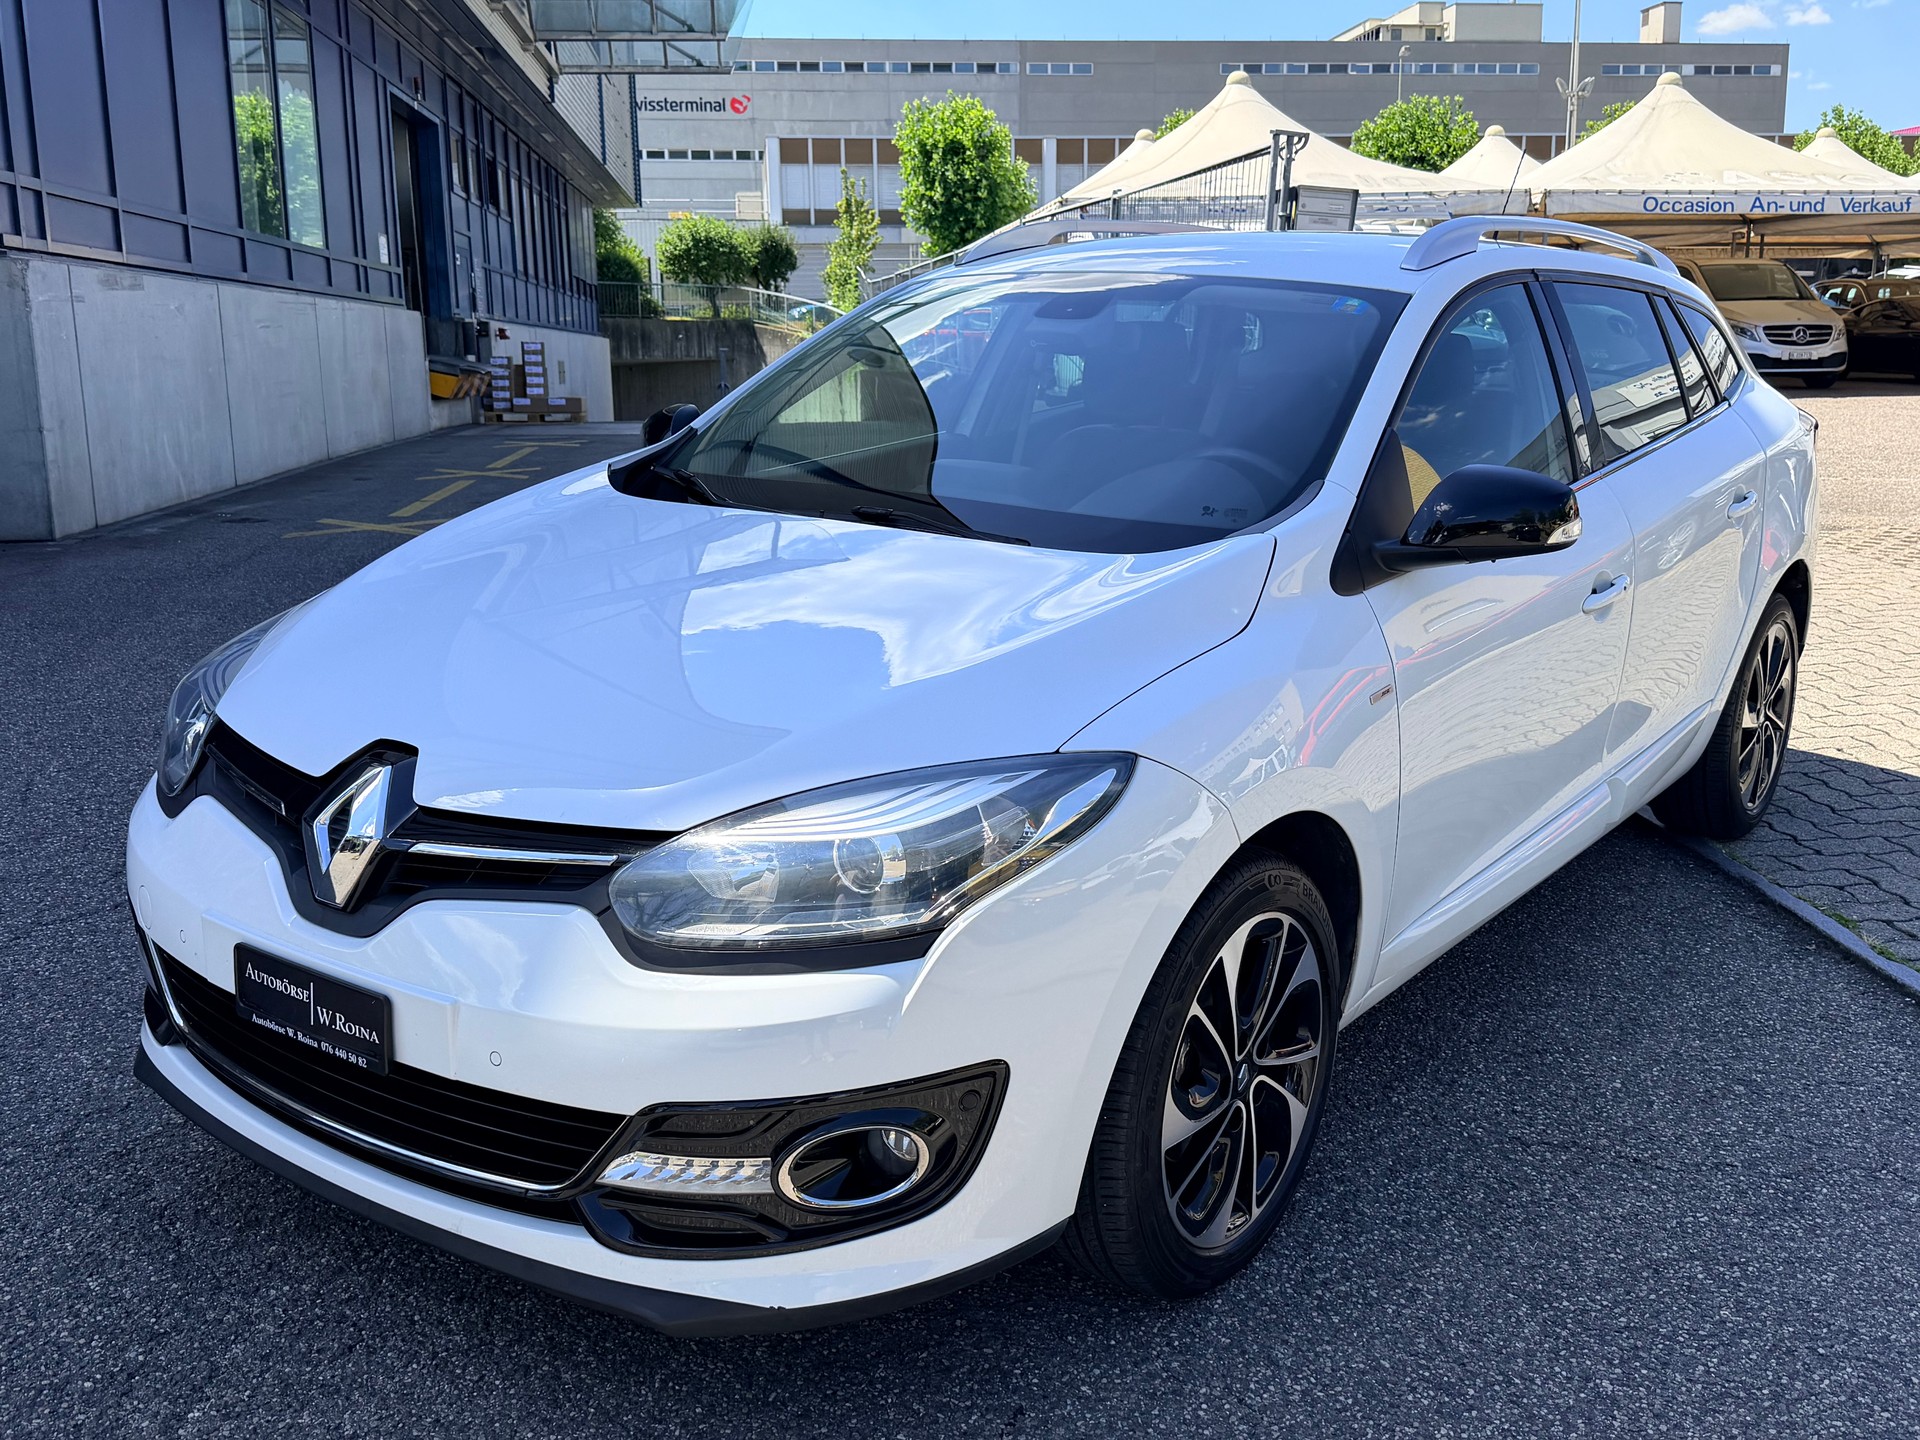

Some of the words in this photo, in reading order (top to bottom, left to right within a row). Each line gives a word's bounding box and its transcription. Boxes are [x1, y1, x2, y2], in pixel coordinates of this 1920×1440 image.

[1642, 196, 1735, 213] Occasion
[1840, 196, 1912, 213] Verkauf
[245, 962, 310, 1003] AUTOBÖRSE
[251, 1013, 286, 1035] Autobörse
[297, 1031, 319, 1048] Roina
[320, 1041, 334, 1055] 076
[334, 1047, 347, 1060] 440
[348, 1052, 357, 1064] 50
[357, 1056, 368, 1069] 82
